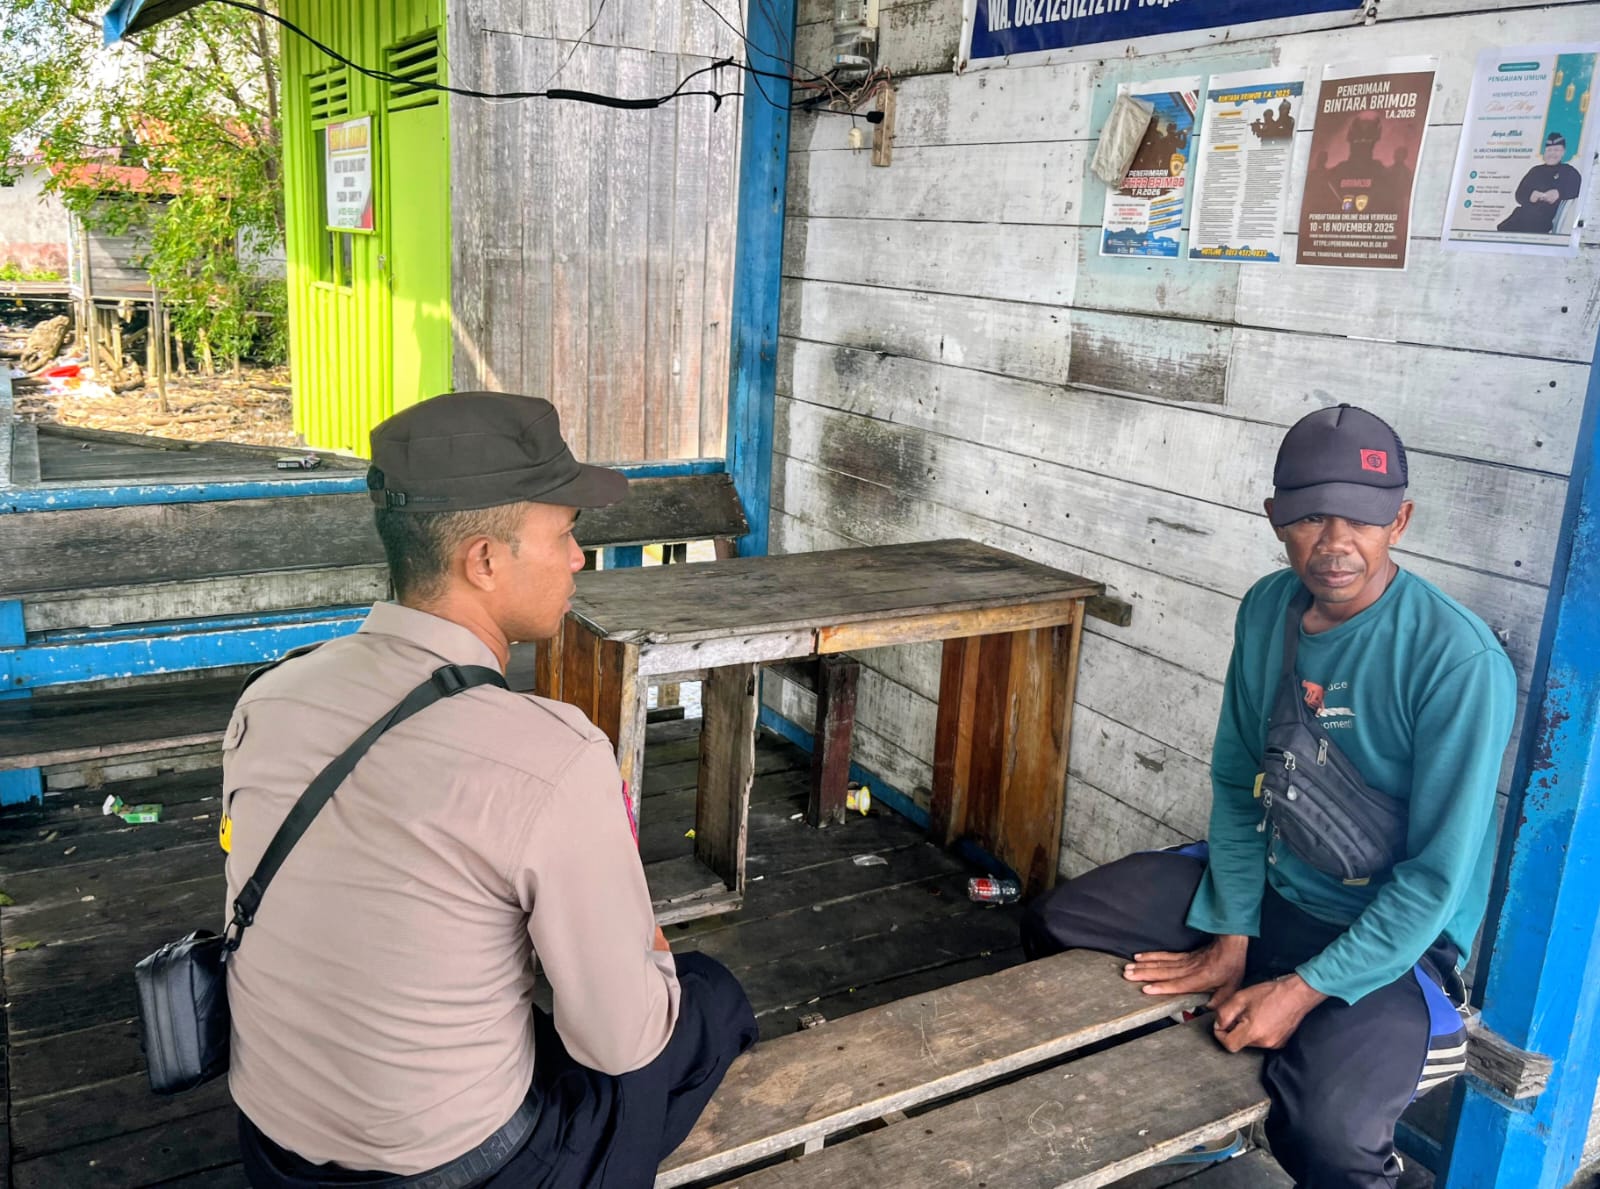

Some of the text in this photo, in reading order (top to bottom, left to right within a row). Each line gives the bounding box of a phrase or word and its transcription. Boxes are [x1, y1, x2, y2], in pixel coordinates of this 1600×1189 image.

[1336, 81, 1391, 97] PENERIMAAN
[1323, 93, 1417, 113] BINTARA BRIMOB
[1310, 222, 1318, 232] 10
[1331, 222, 1372, 233] NOVEMBER
[1374, 222, 1395, 233] 2025
